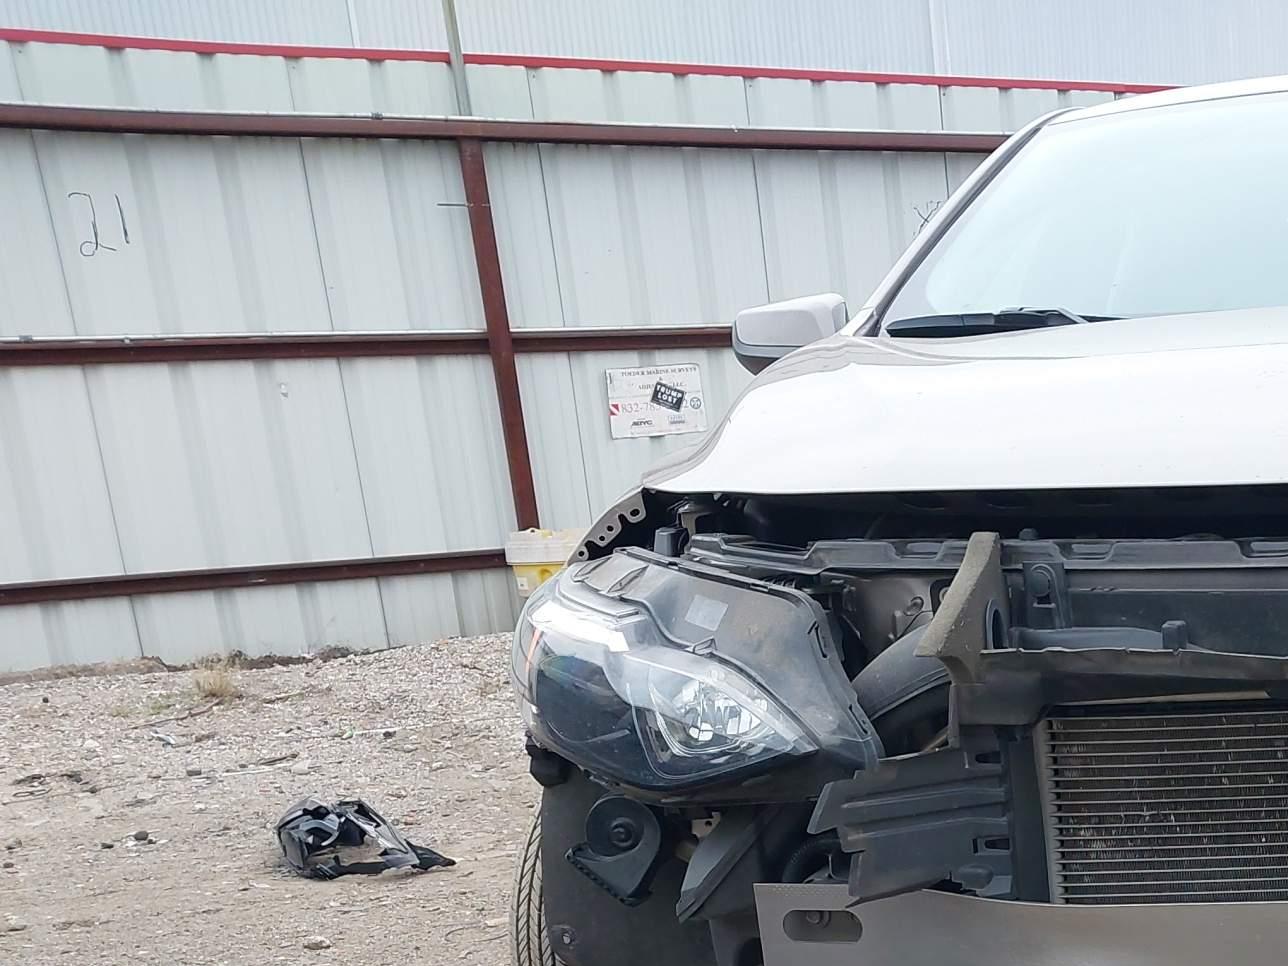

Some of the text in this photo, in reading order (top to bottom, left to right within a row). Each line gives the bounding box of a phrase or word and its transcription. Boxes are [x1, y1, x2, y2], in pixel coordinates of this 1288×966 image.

[68, 191, 130, 257] 21
[656, 384, 682, 399] TRUMP
[657, 391, 677, 404] LOST
